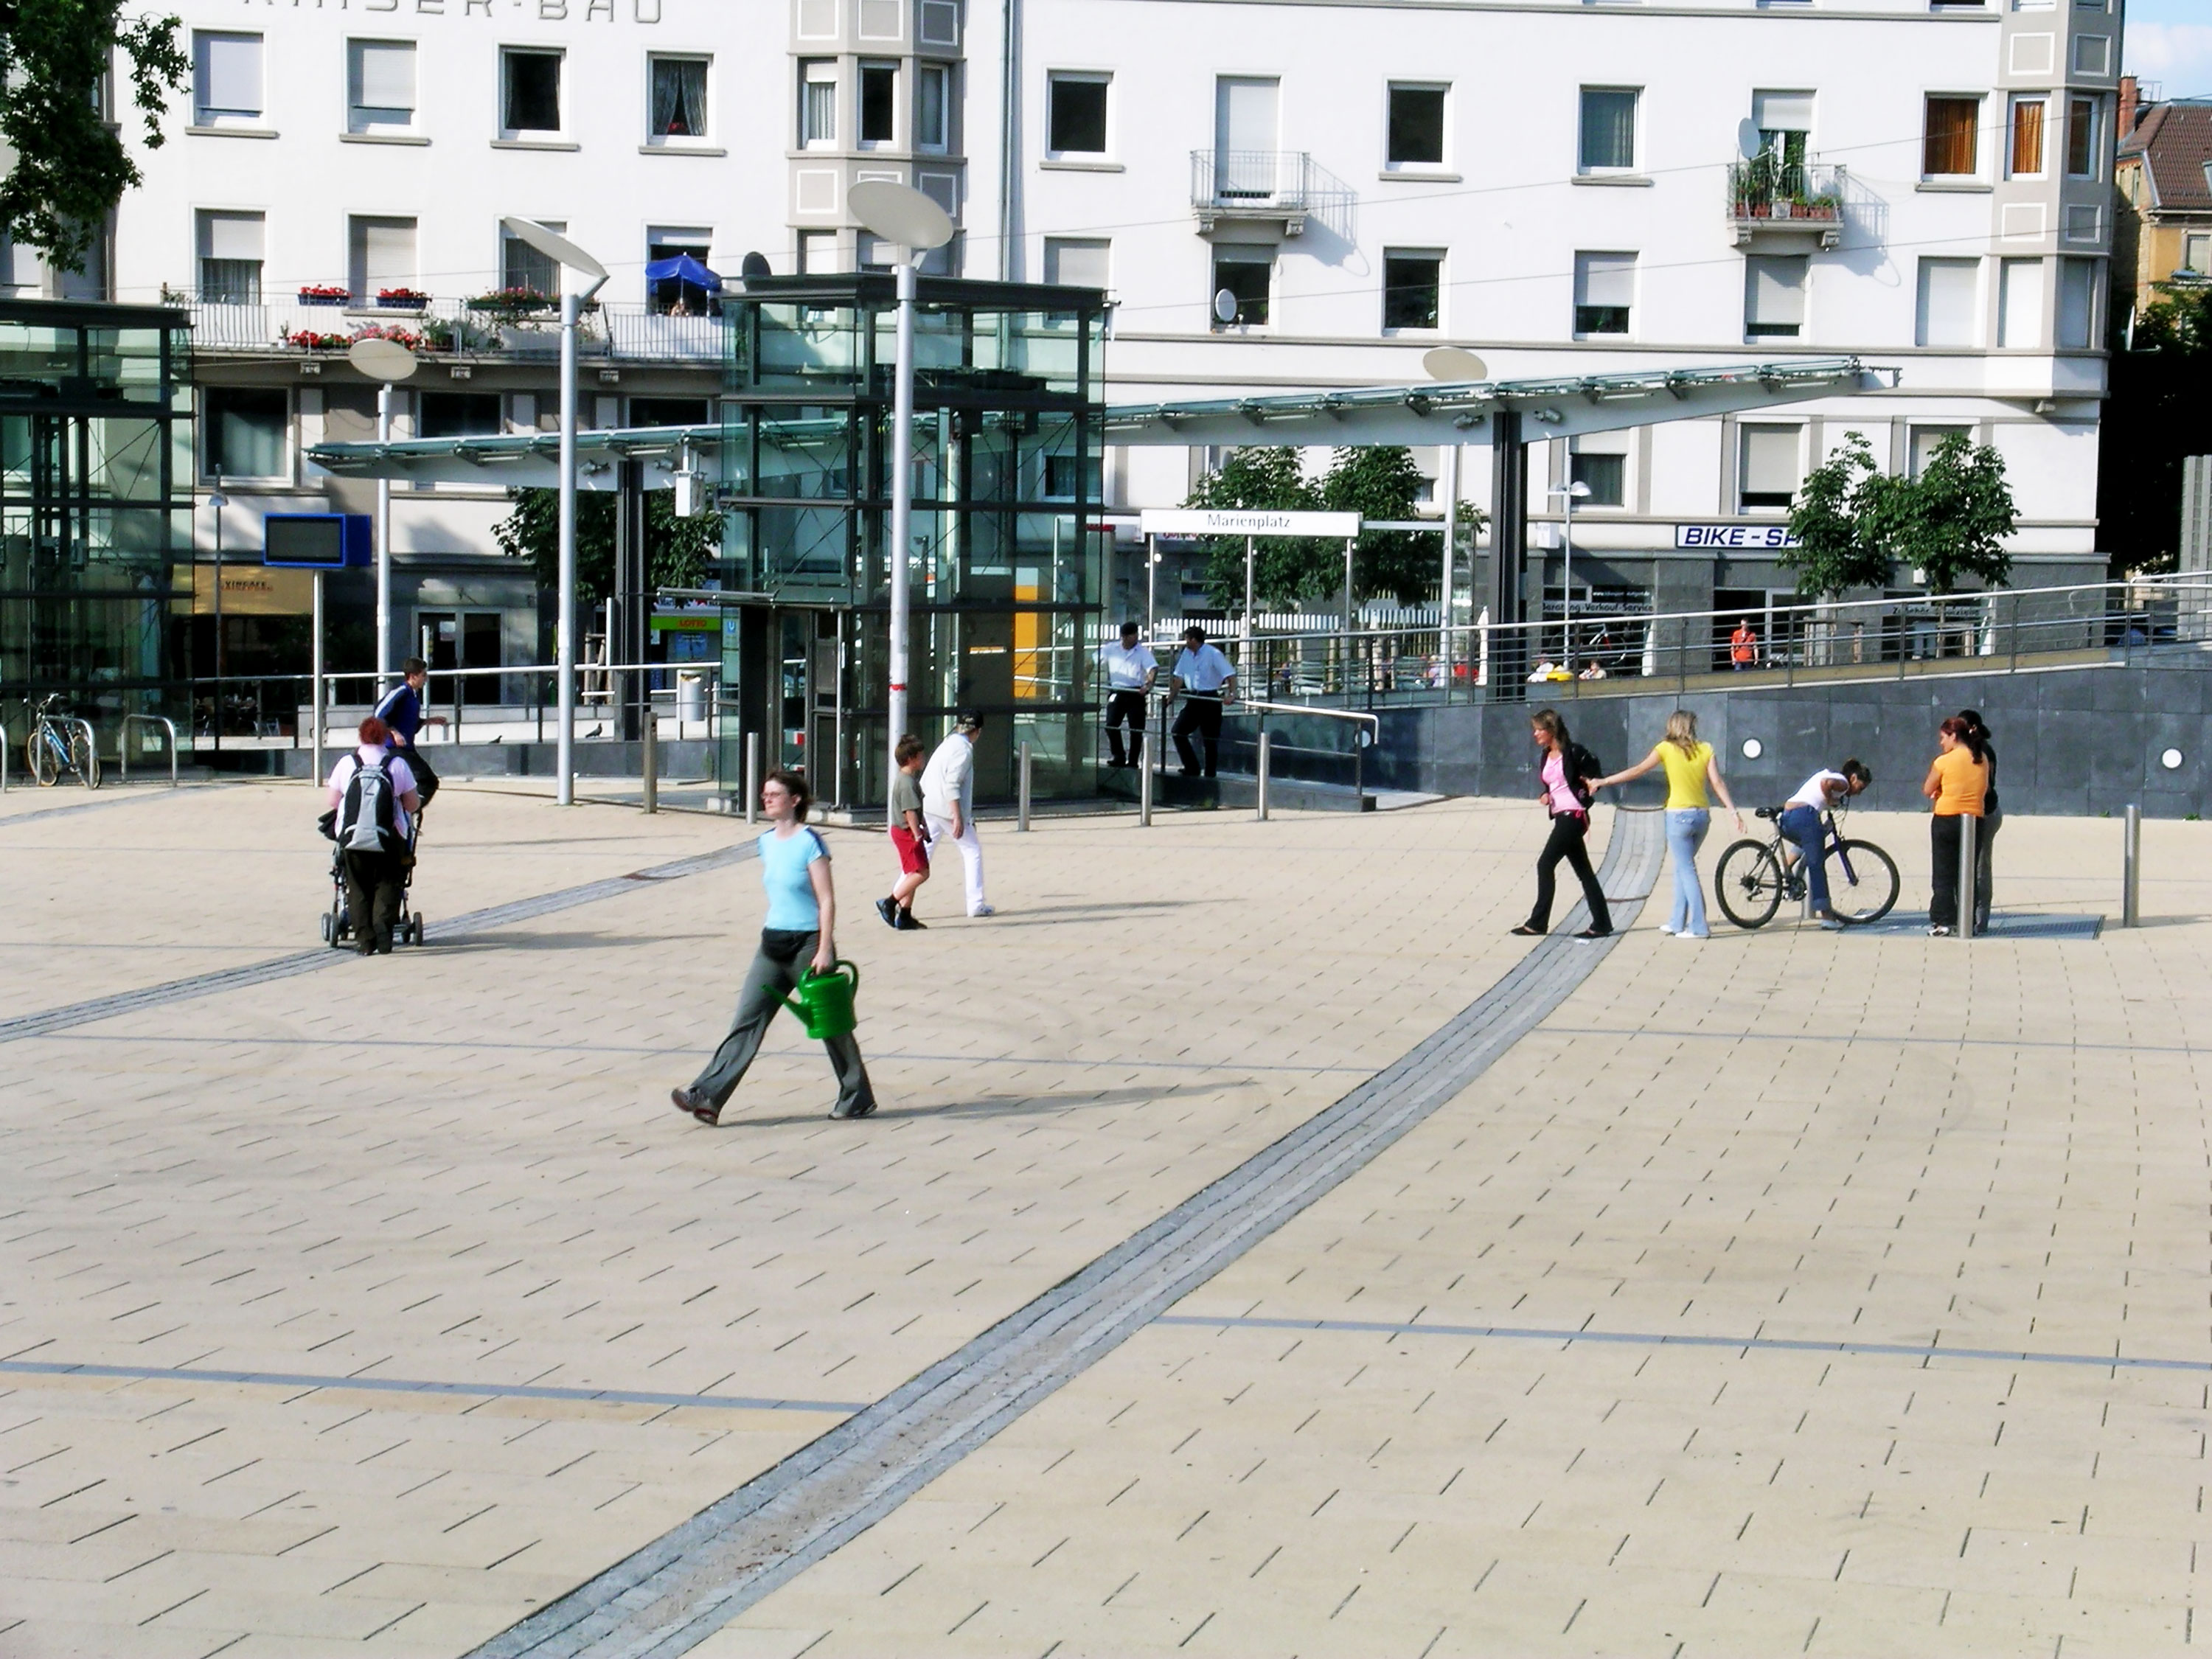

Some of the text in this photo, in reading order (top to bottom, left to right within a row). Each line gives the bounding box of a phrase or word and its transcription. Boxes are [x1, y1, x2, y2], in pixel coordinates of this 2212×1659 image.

[1207, 512, 1291, 531] Marienplatz
[1684, 527, 1746, 546] BIKE
[1542, 602, 1581, 613] Beratng
[1623, 602, 1654, 611] Service
